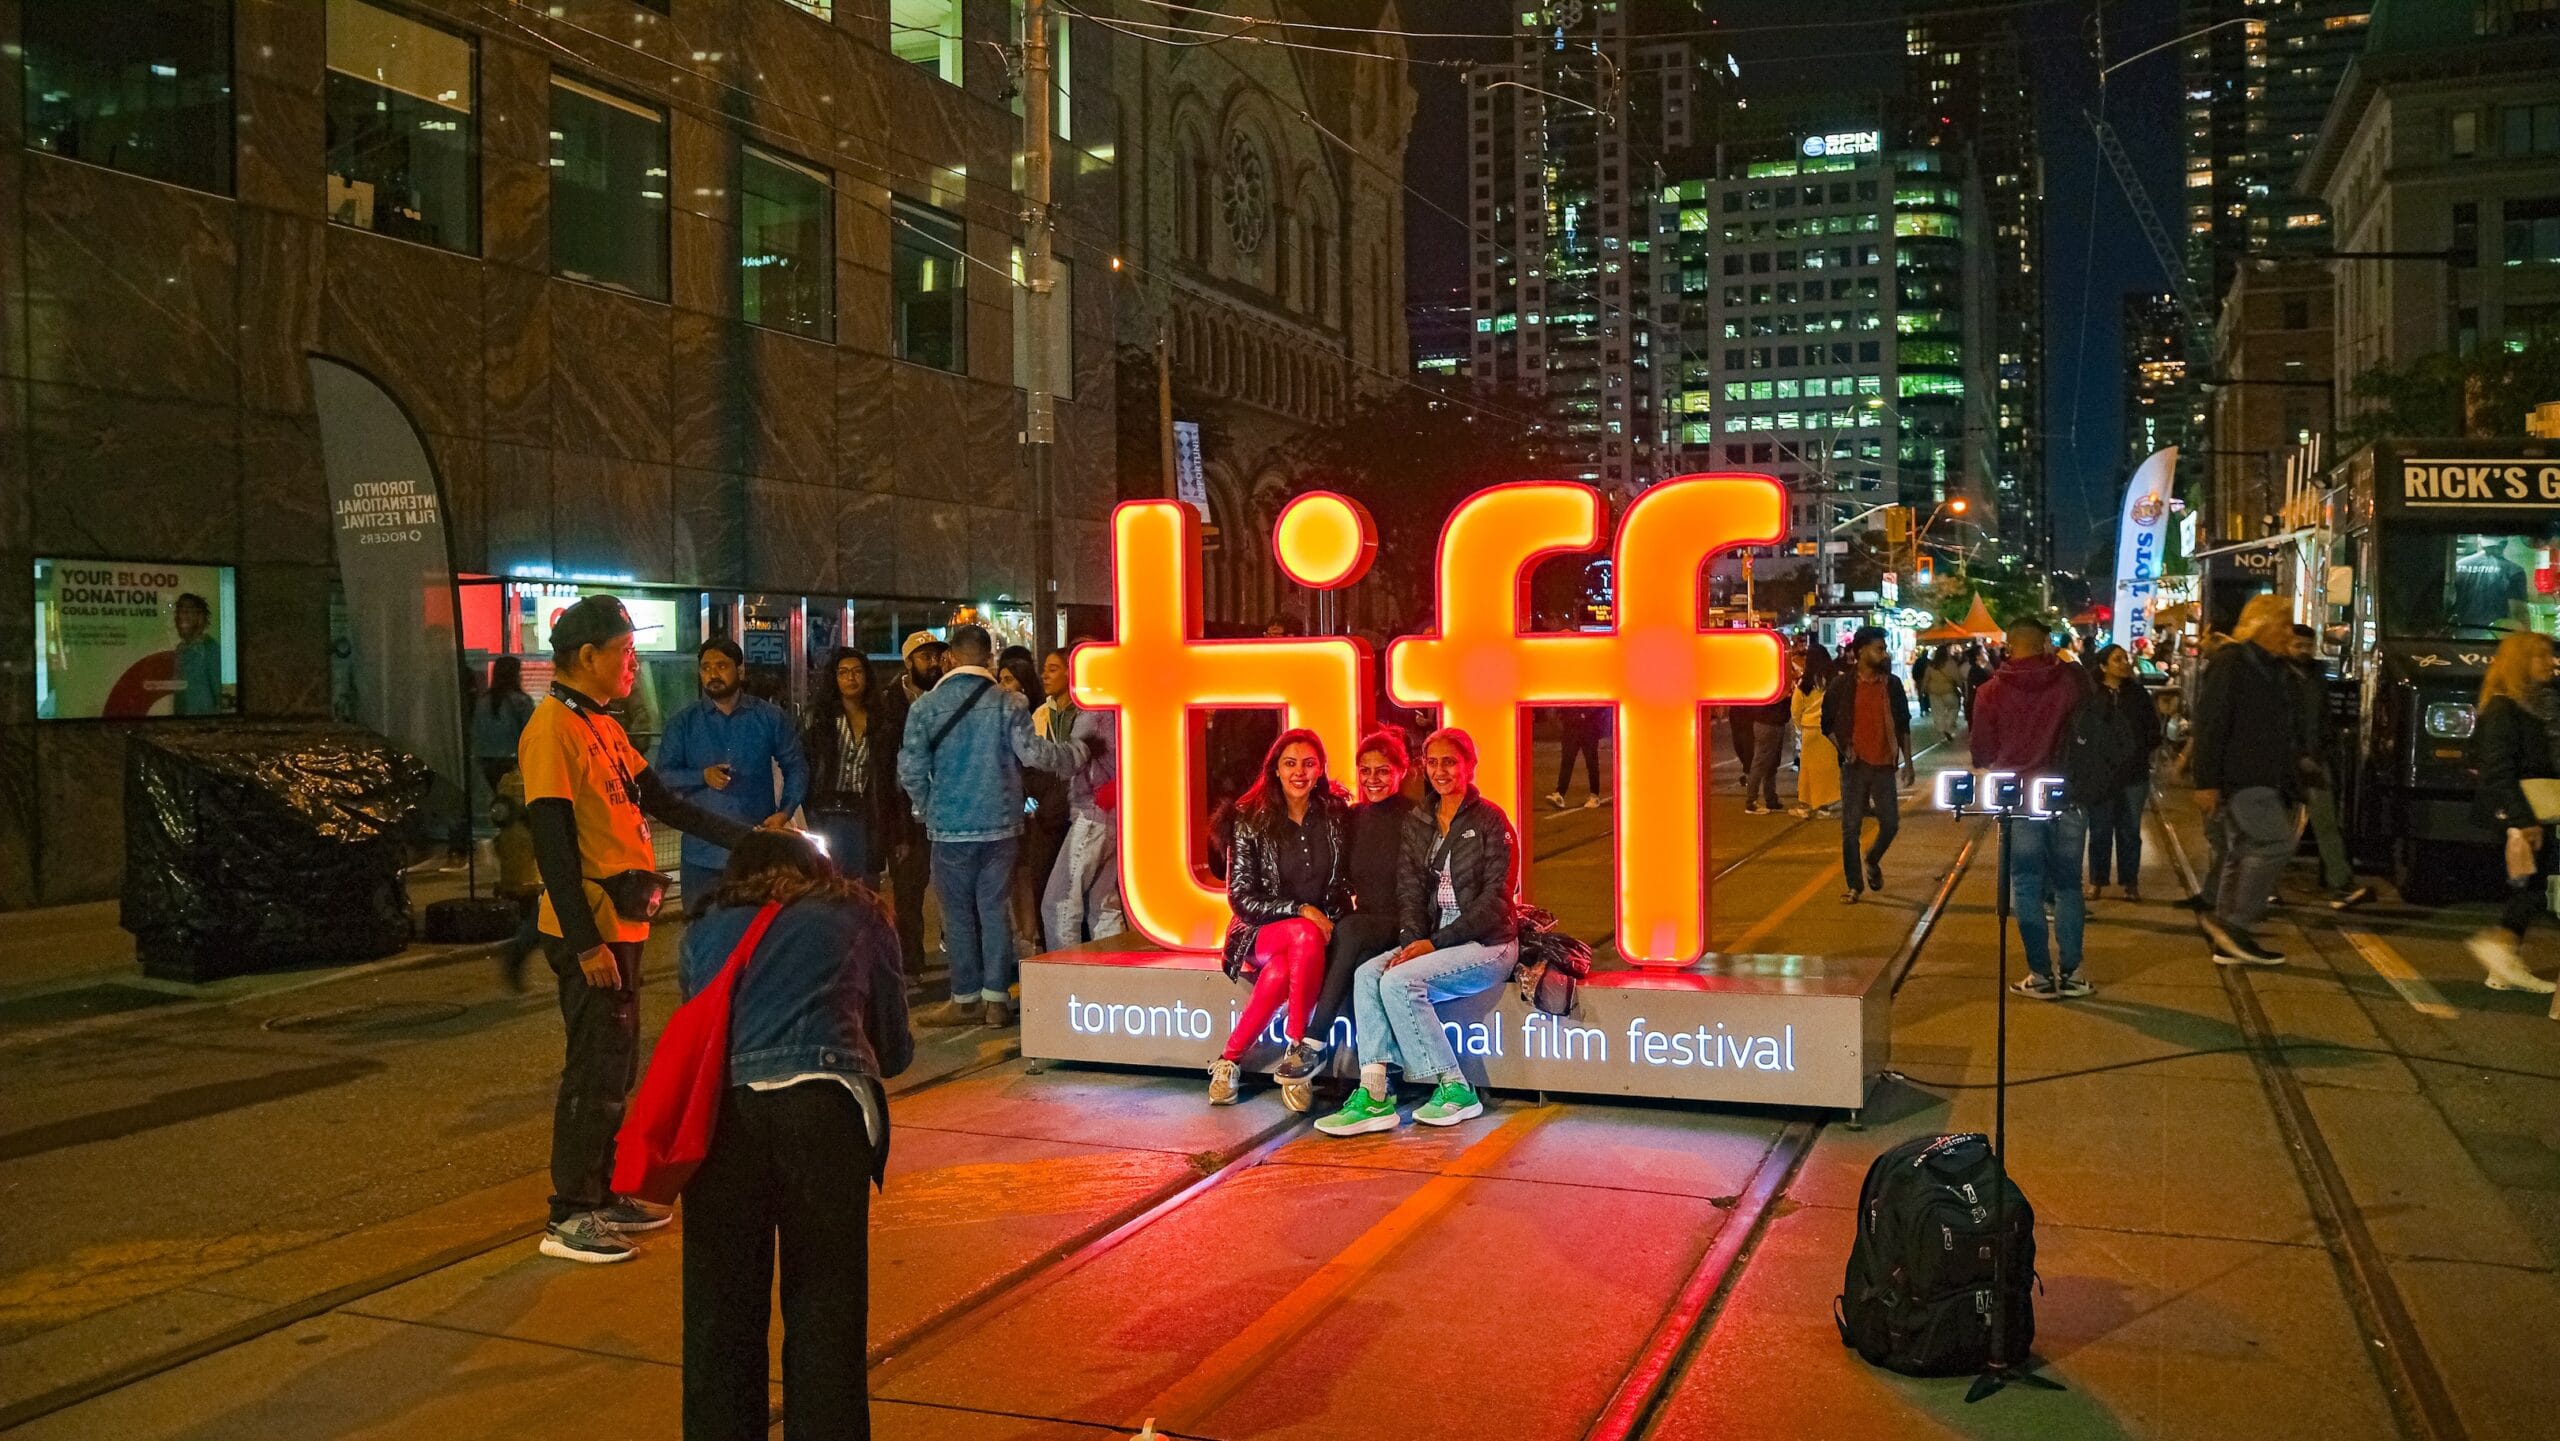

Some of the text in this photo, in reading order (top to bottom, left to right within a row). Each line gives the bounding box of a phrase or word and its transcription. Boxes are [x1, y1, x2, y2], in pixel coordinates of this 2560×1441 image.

[1825, 131, 1878, 144] SPIN
[1825, 143, 1878, 156] MASTER
[2404, 466, 2529, 499] RICK'S
[61, 569, 179, 588] YOUR BLOOD
[61, 588, 158, 606] DONATION
[61, 606, 158, 618] COULD SAVE LIVES
[1068, 471, 1788, 969] tiff
[1068, 993, 1213, 1040] toronto
[1521, 1013, 1608, 1062] film
[1626, 1017, 1796, 1072] festival
